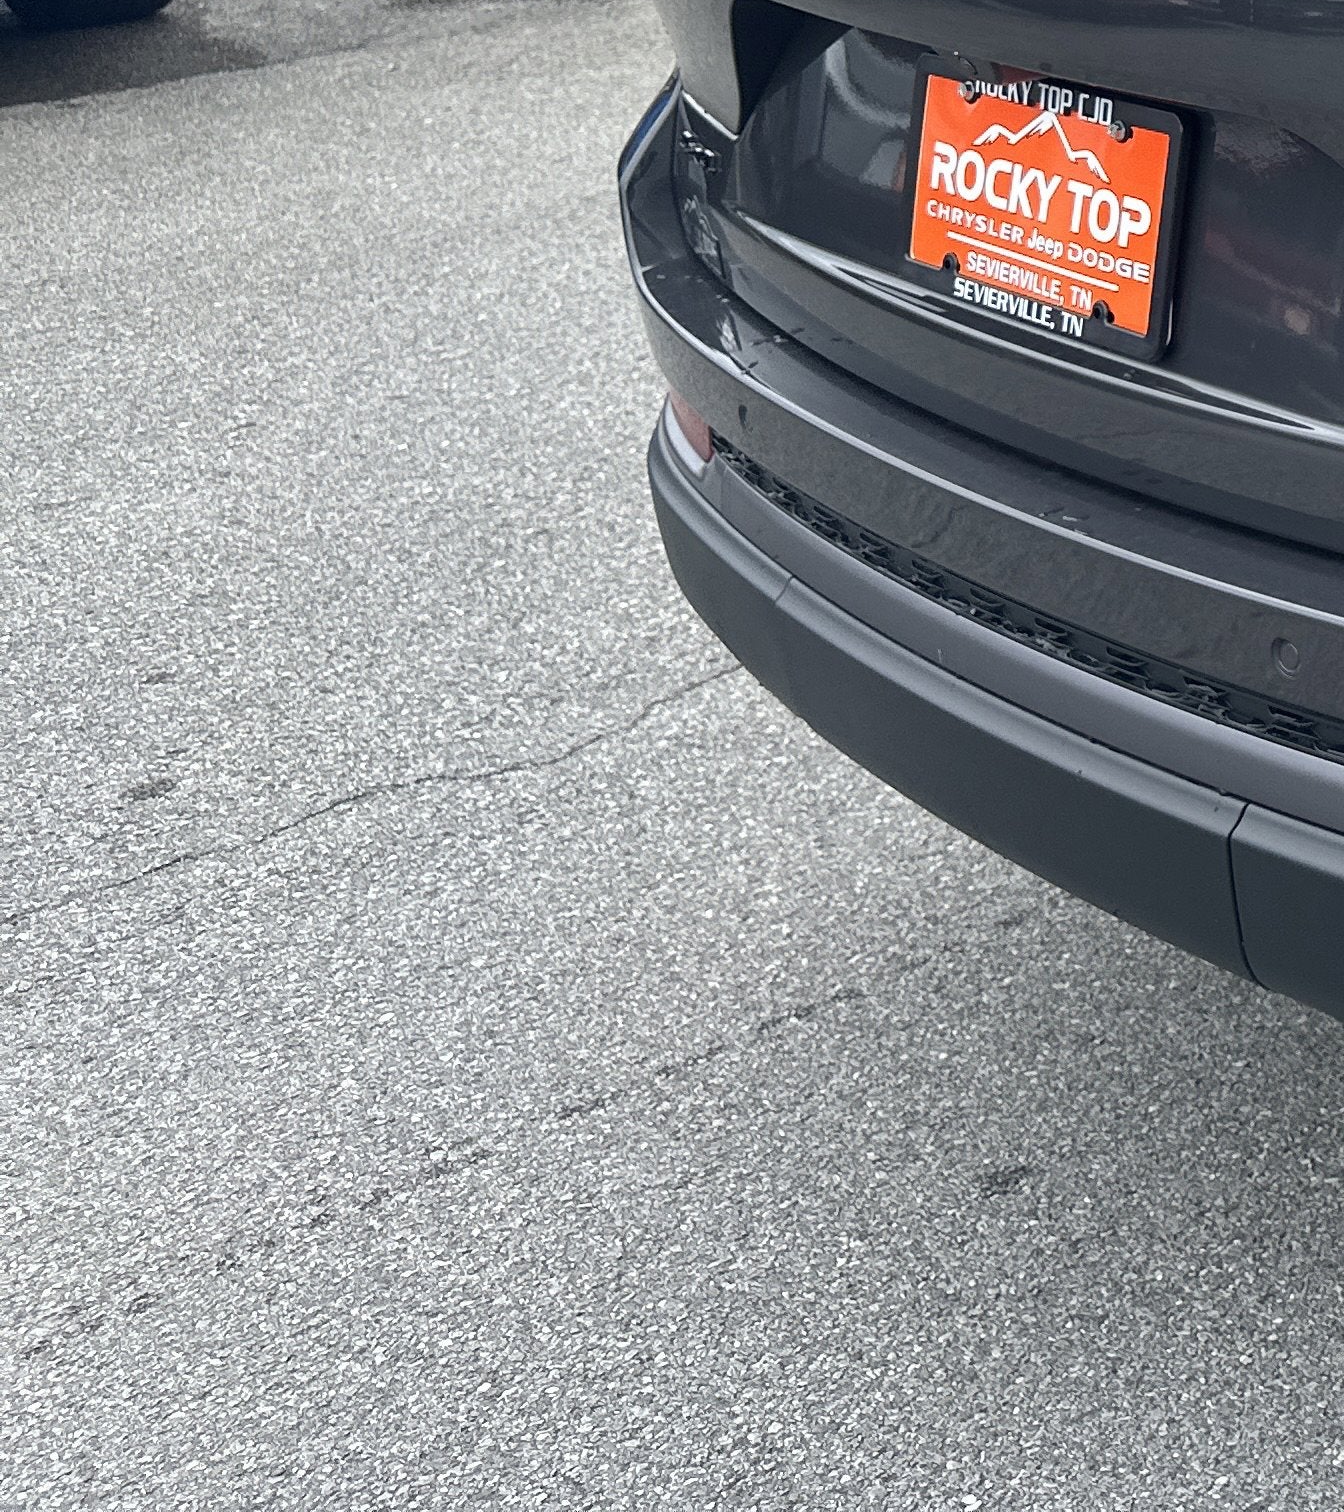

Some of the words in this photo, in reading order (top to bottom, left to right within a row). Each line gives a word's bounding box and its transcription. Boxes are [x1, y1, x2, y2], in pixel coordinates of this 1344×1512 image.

[1038, 82, 1073, 116] TOP
[1077, 92, 1114, 126] CJD
[930, 139, 1063, 224] ROCKY
[1067, 178, 1152, 249] TOP
[926, 198, 1025, 245] CHRYSLER
[1027, 227, 1064, 260] Jeep
[1067, 241, 1152, 285] DODGE
[953, 276, 1056, 330] SEVIERVILLE,
[1060, 311, 1084, 337] TN
[966, 250, 1065, 306] SEVIERVILLE,
[1069, 284, 1094, 311] TN
